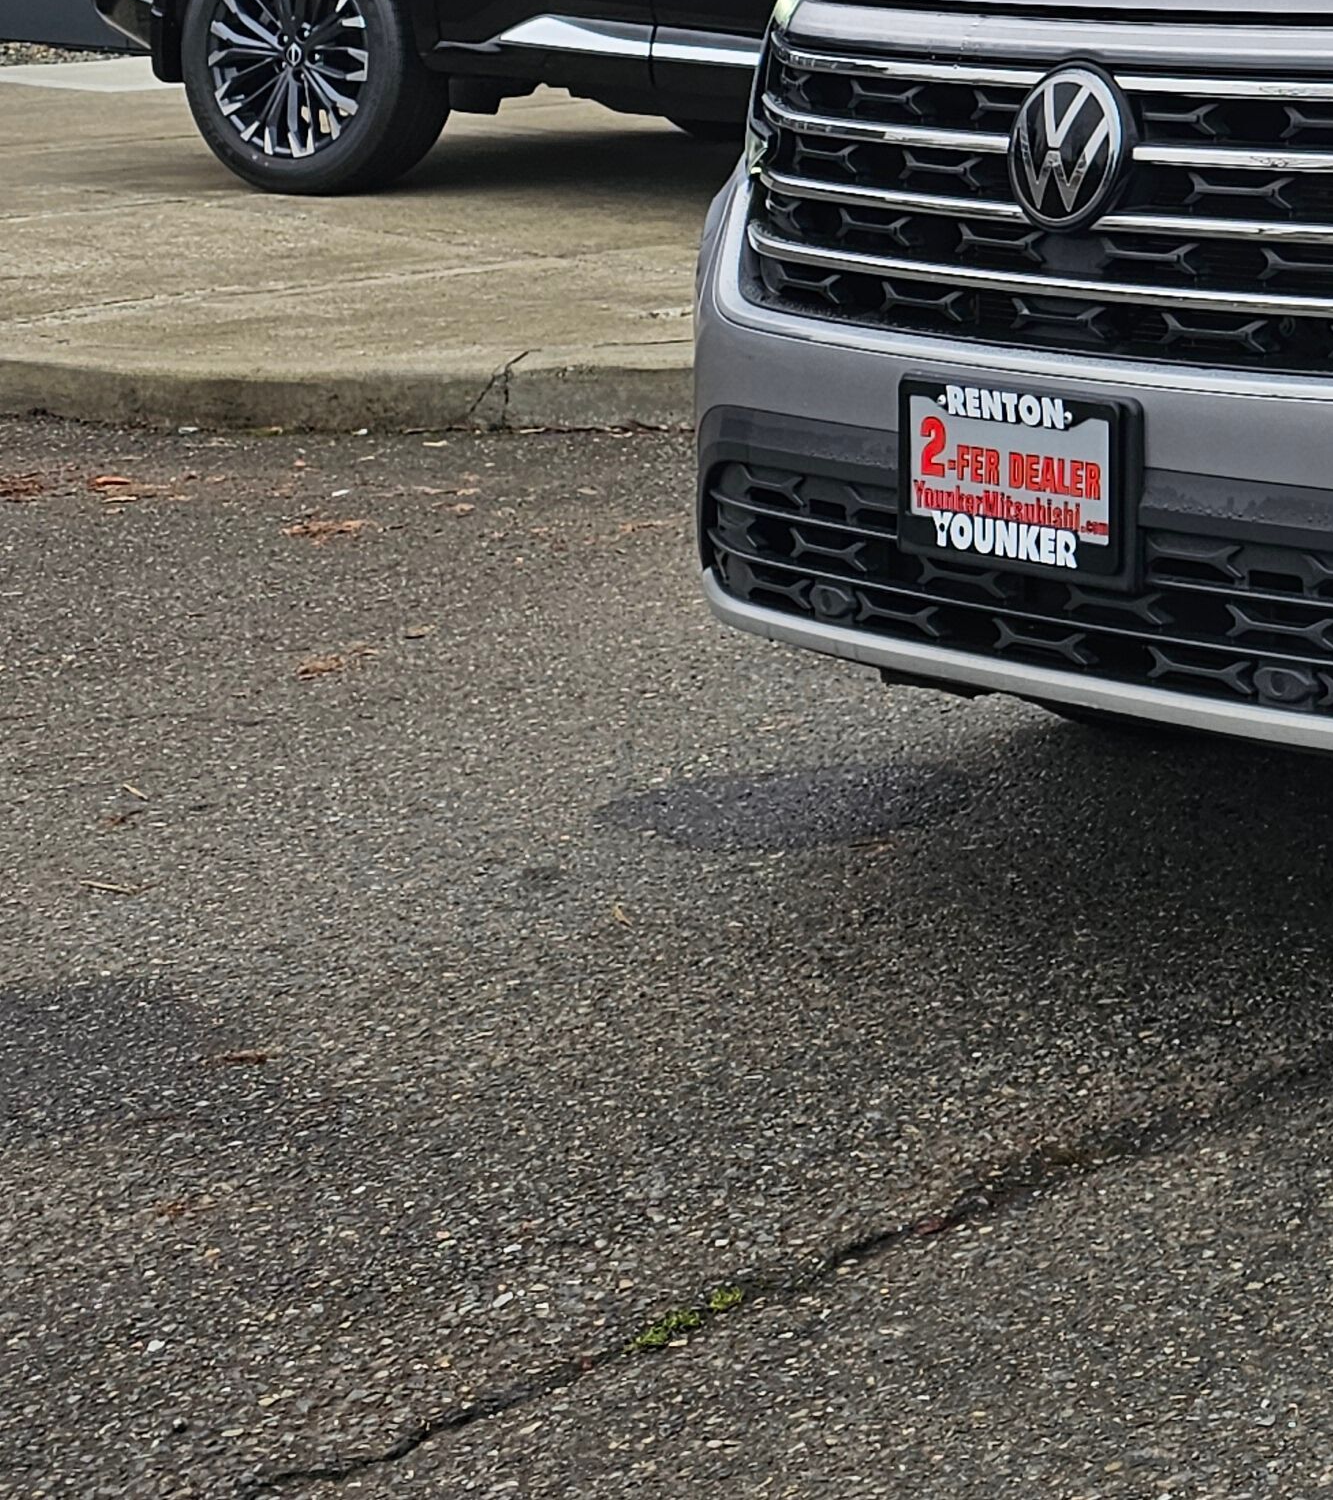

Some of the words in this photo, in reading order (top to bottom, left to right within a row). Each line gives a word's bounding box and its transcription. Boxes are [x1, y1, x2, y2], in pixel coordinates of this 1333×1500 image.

[945, 384, 1066, 430] RENTON
[919, 415, 1001, 487] 2-FER
[1008, 451, 1101, 500] DEALER
[912, 479, 1109, 537] YounkerMitsubishi.com
[931, 510, 1079, 569] YOUNKER
